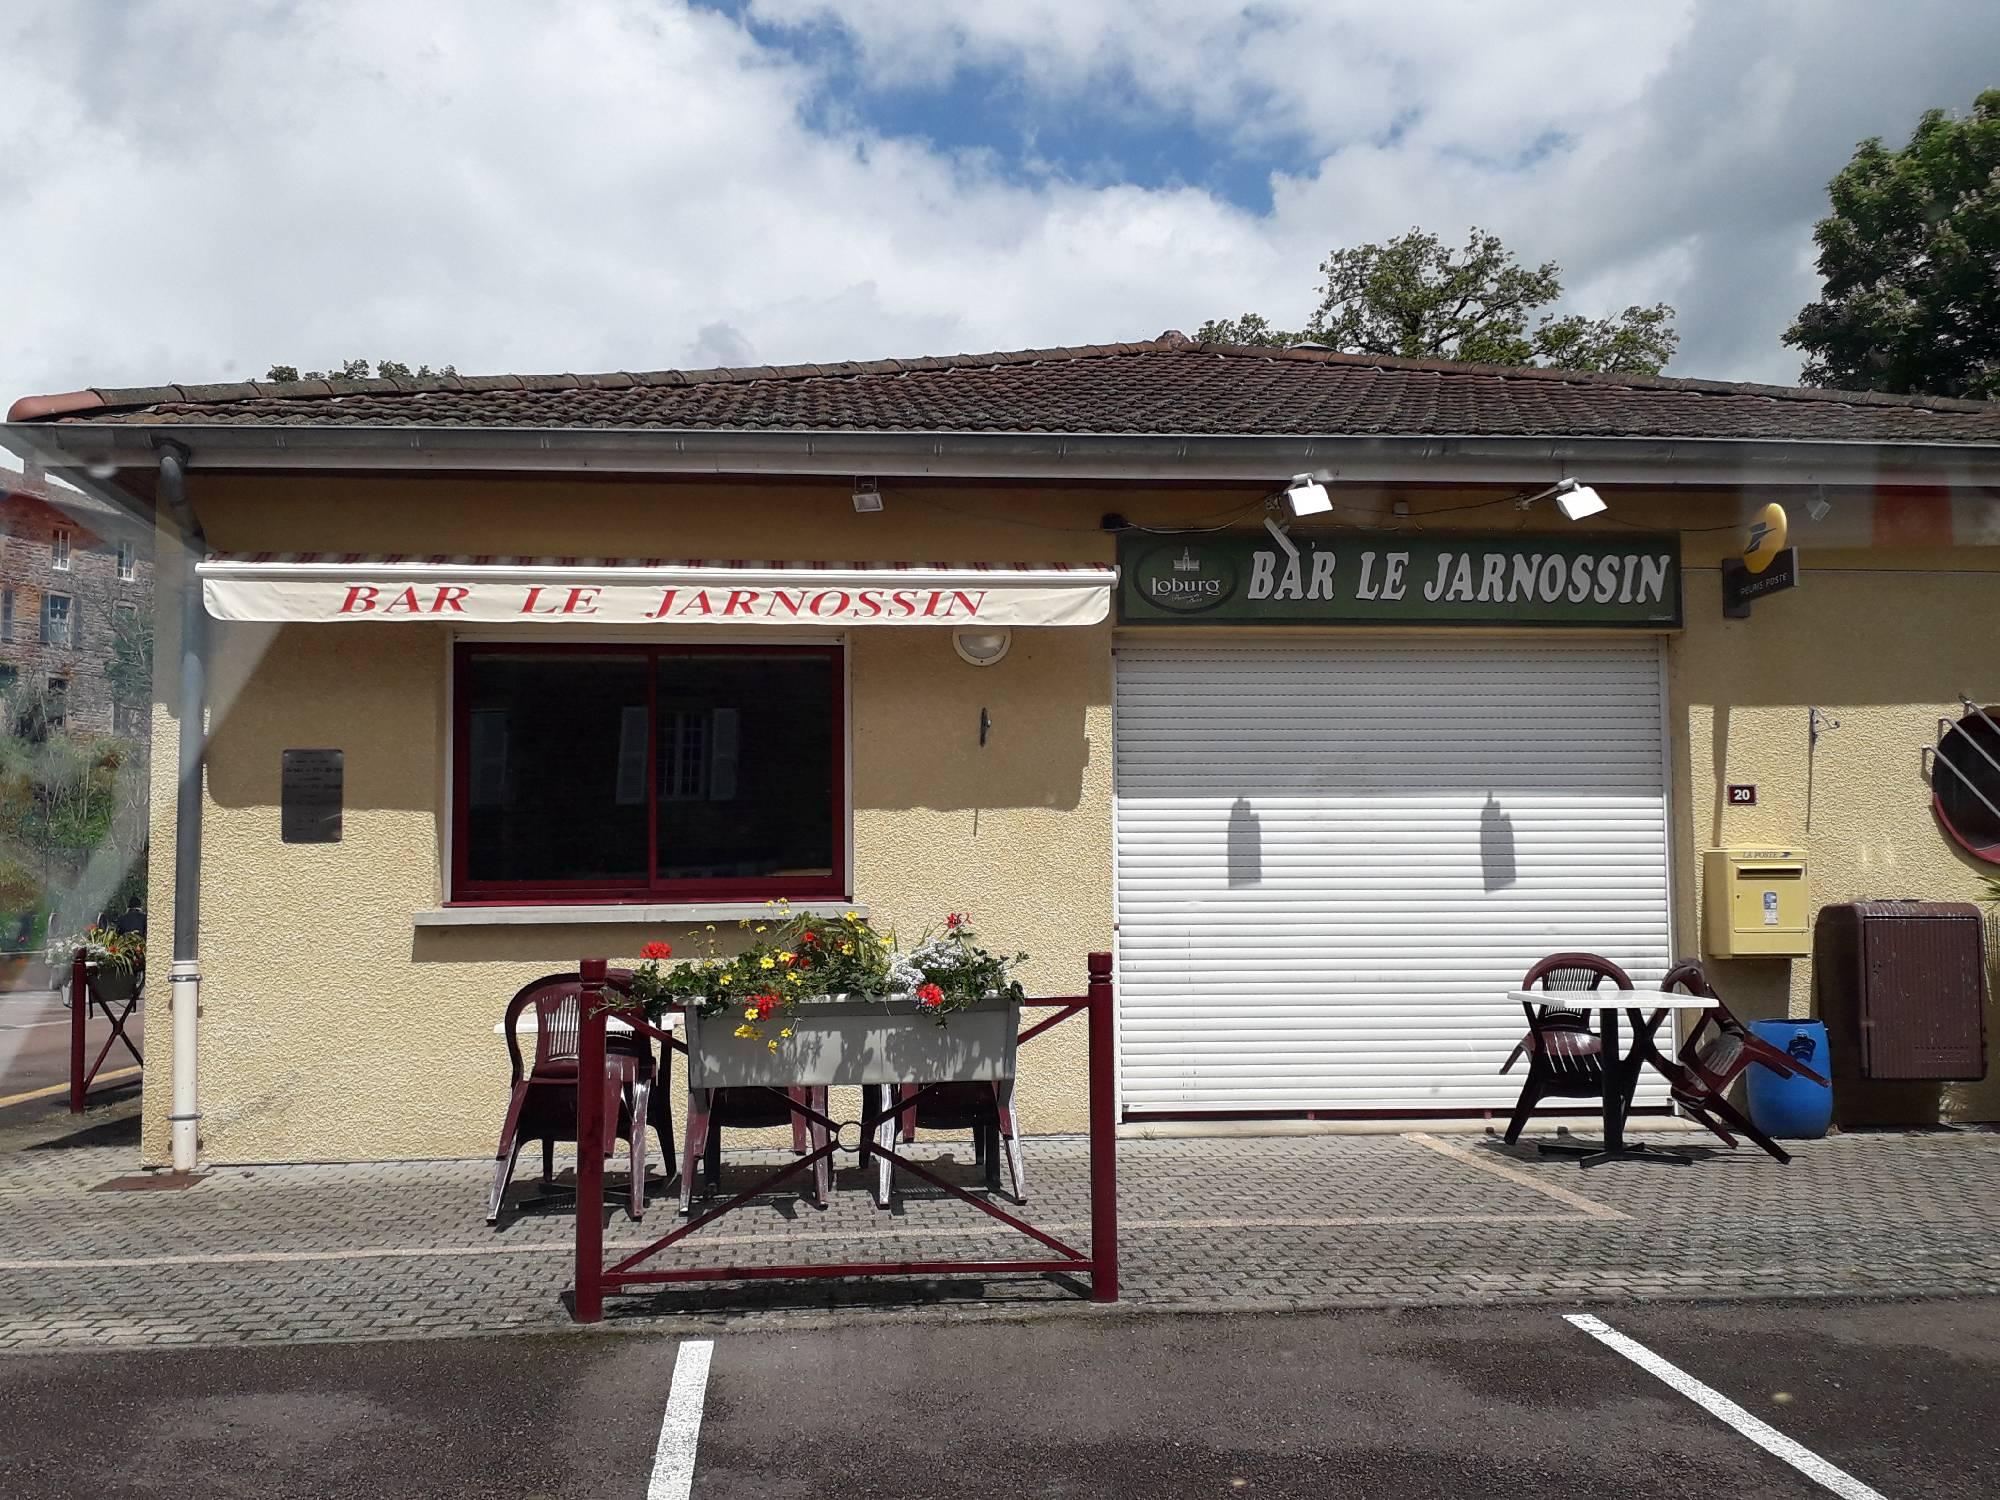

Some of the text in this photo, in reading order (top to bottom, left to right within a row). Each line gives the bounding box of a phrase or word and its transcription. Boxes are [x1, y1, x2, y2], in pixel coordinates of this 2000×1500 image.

[1248, 550, 1670, 604] BAR LE JARNOSSIN
[1765, 573, 1787, 586] POSTE
[1151, 576, 1221, 596] Loburg
[339, 584, 987, 618] BAR LE JARNOSSIN
[1734, 789, 1750, 801] 20
[1743, 851, 1777, 859] LA POSTE
